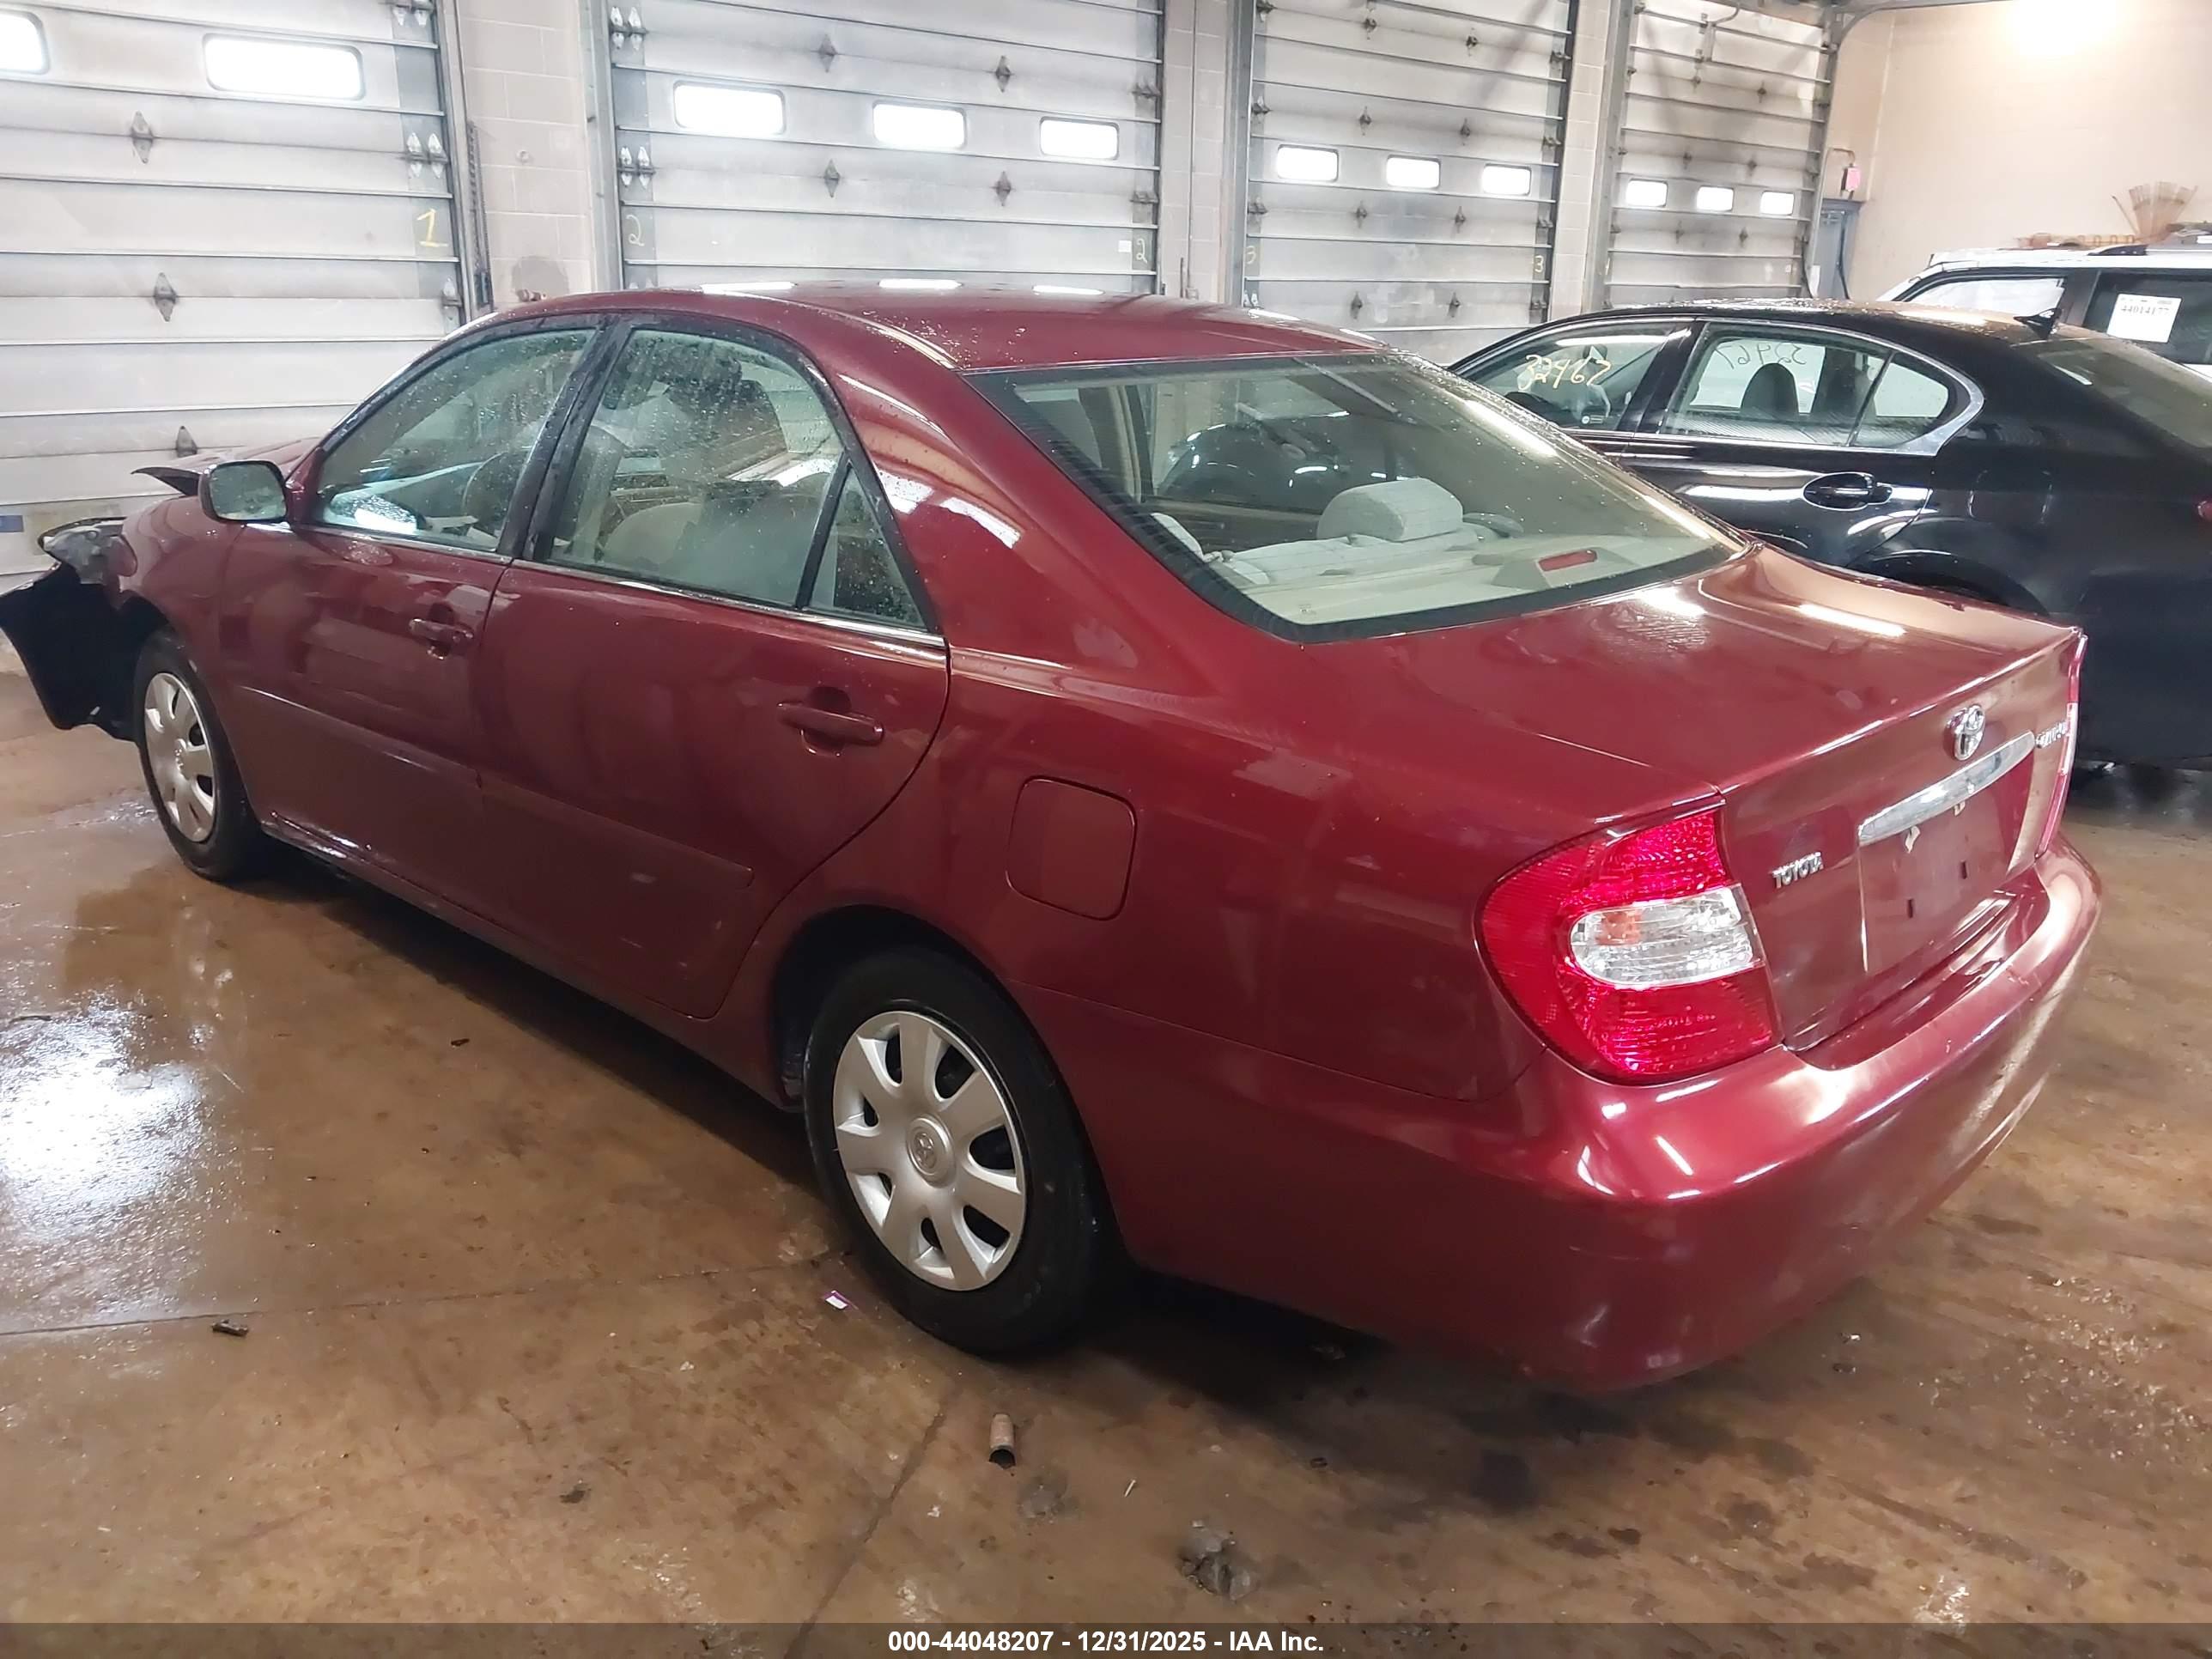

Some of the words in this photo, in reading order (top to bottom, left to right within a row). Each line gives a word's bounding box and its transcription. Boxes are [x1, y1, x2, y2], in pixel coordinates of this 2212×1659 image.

[416, 208, 448, 247] 1
[626, 214, 645, 247] 2
[1136, 237, 1148, 264] 2
[1245, 245, 1257, 264] 3
[1534, 255, 1544, 273] 3
[1772, 851, 1824, 889] TOYOTA
